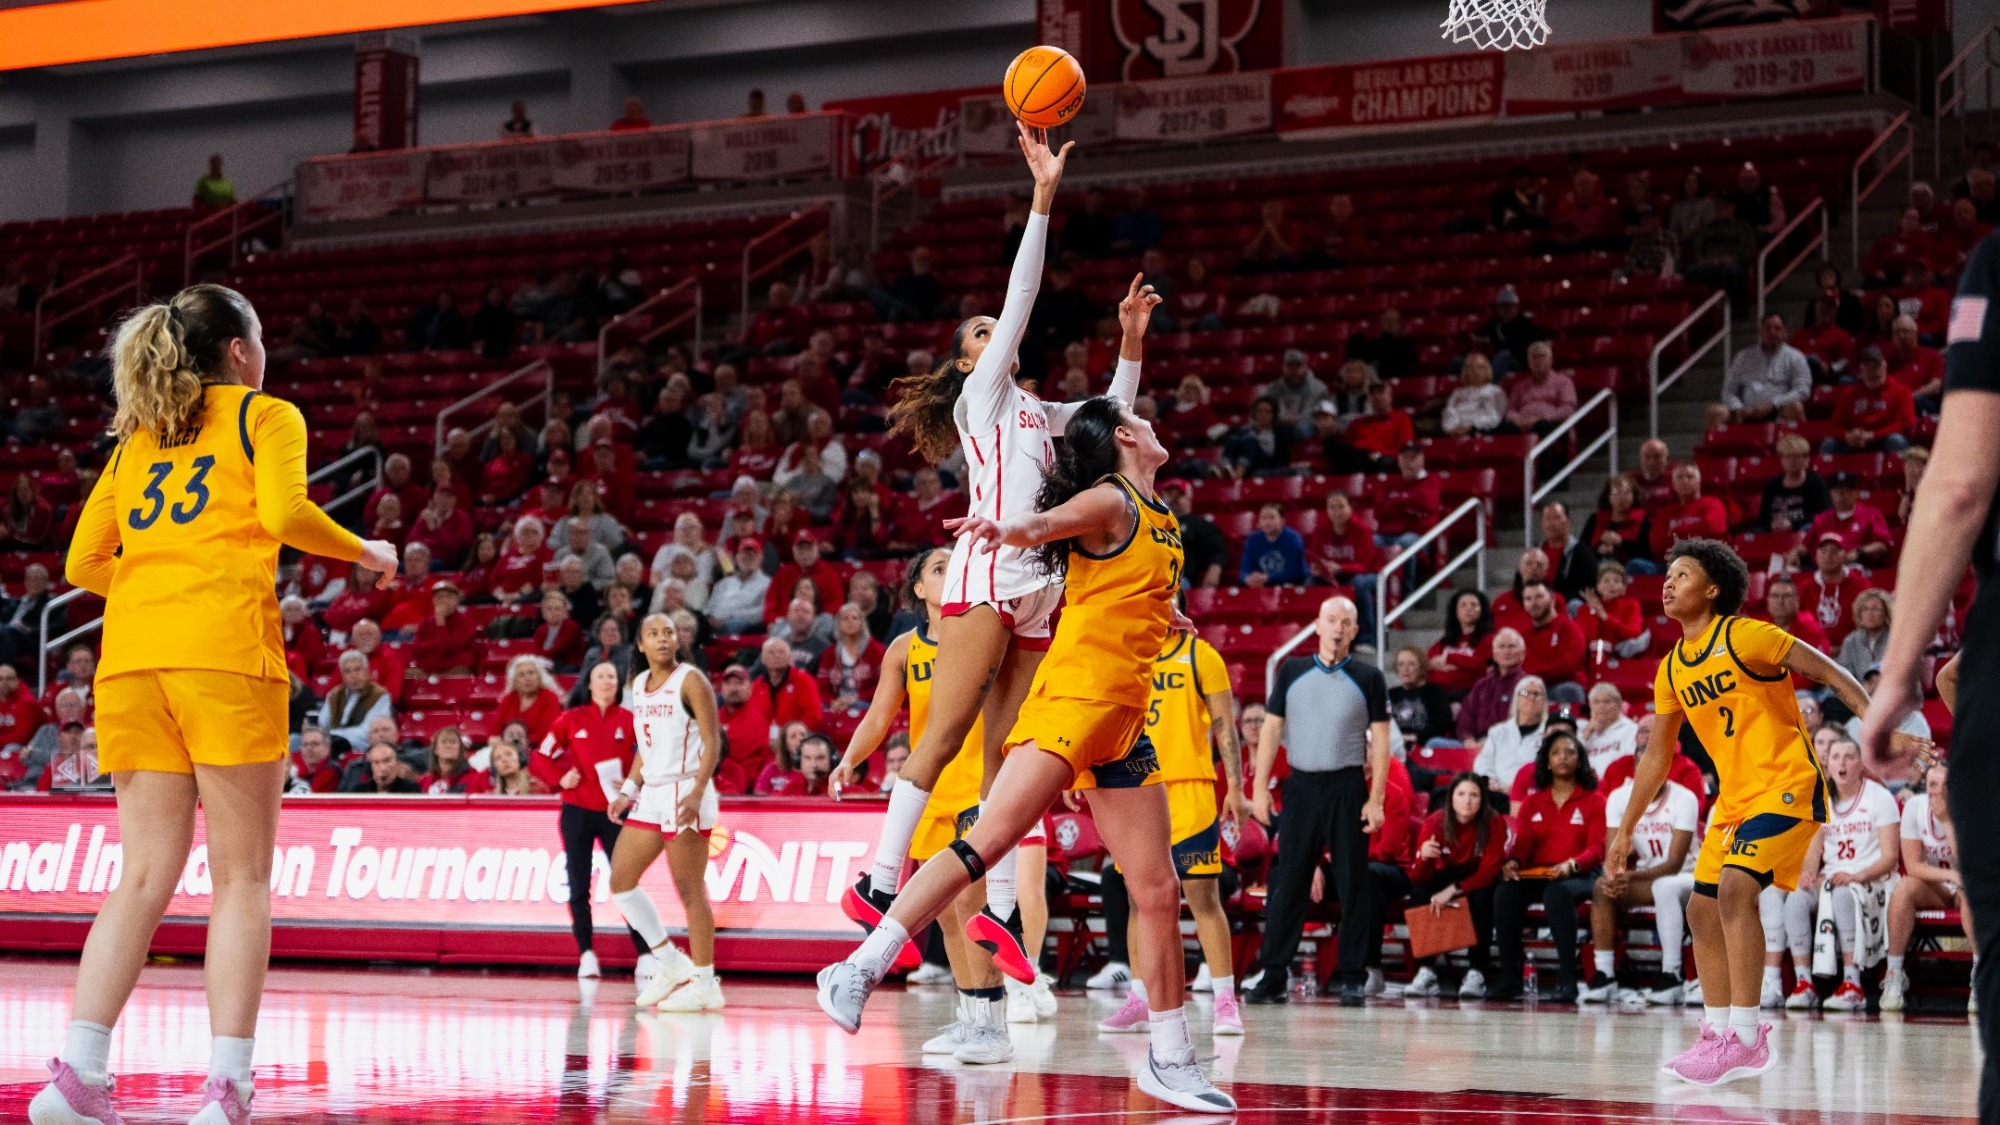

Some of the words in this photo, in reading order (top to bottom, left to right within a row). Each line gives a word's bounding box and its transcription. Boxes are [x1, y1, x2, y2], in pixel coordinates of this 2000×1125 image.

[1761, 31, 1855, 58] BASKETBALL
[1353, 63, 1426, 91] REGULAR
[1429, 57, 1495, 84] SEASON
[1553, 48, 1633, 73] VOLLEYBALL
[1732, 59, 1815, 89] 2019-20
[1351, 80, 1494, 123] CHAMPIONS
[128, 454, 216, 531] 33
[1152, 672, 1185, 692] NC
[1680, 670, 1737, 709] UNC
[643, 723, 652, 748] 5
[1719, 706, 1735, 738] 2
[1179, 852, 1220, 867] UNC
[1648, 839, 1663, 857] 11
[1837, 839, 1856, 861] 25
